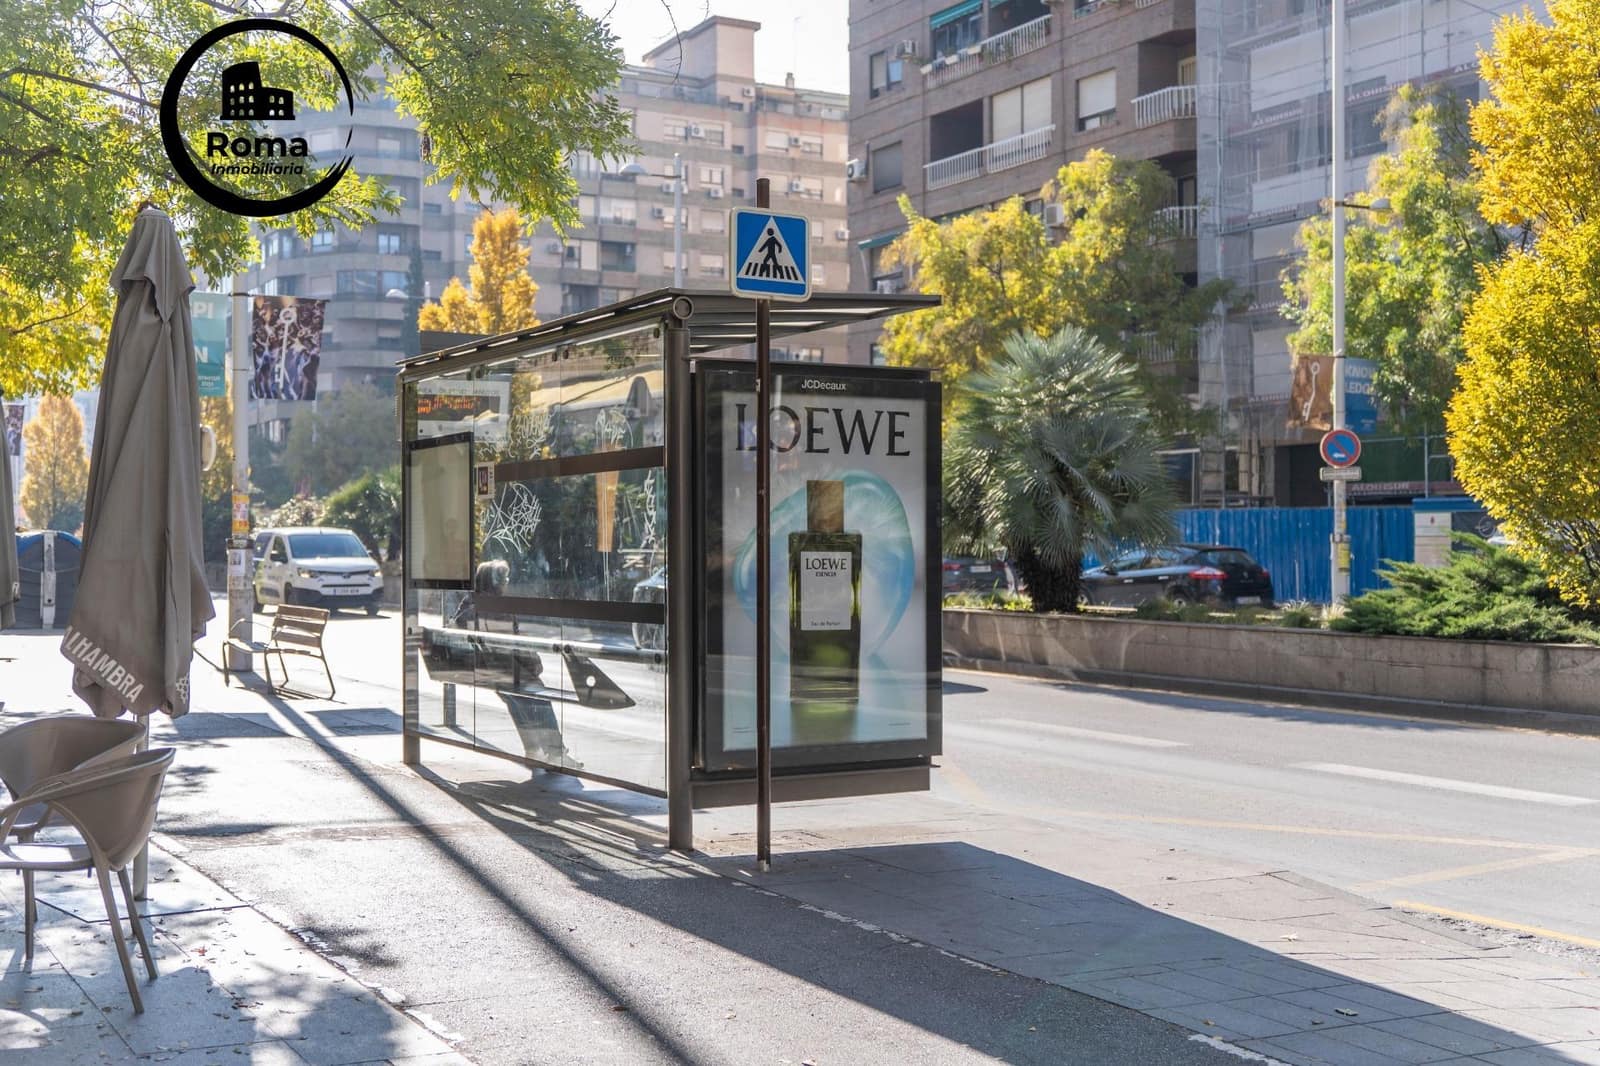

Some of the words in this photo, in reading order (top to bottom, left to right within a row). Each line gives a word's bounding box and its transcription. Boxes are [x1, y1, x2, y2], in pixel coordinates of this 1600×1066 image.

[801, 379, 847, 391] JCDecaux
[735, 403, 911, 457] LOEWE
[805, 558, 847, 570] LOEWE
